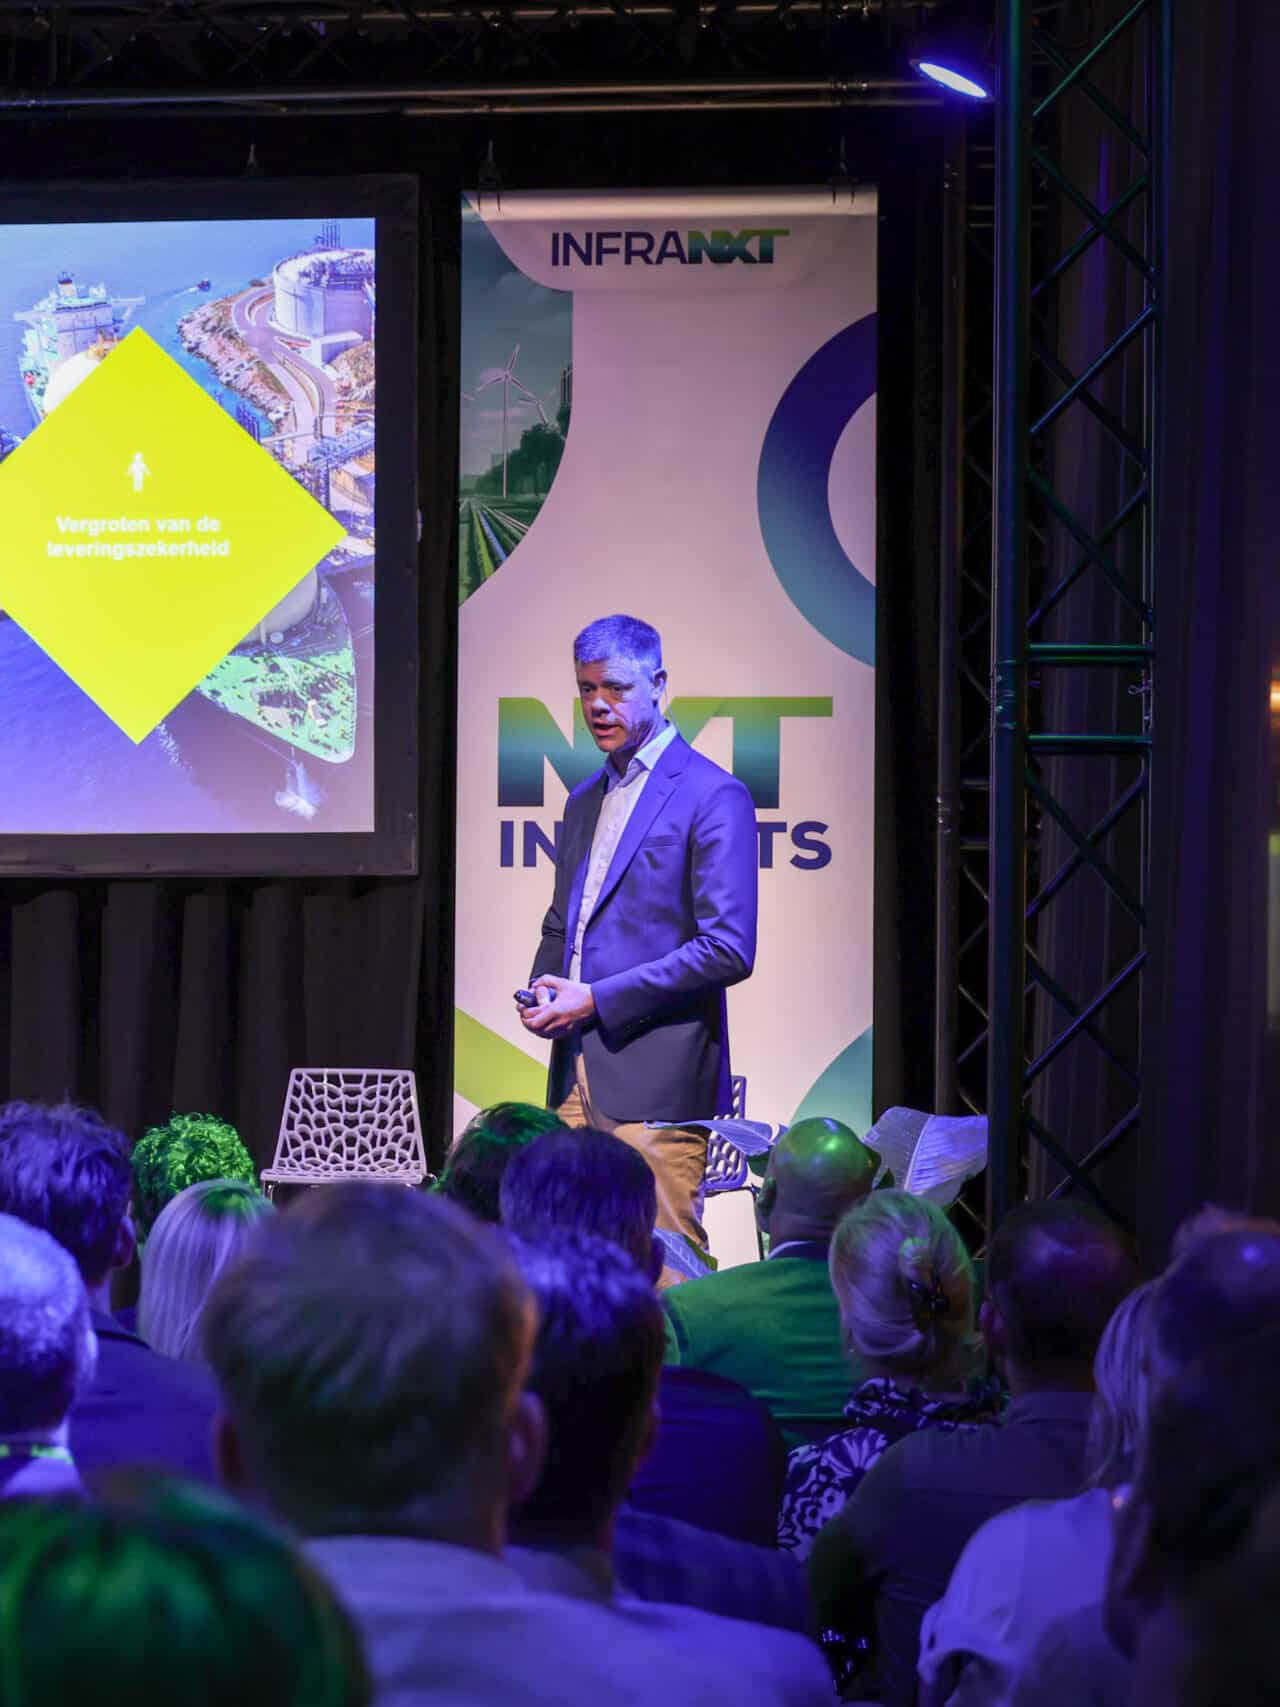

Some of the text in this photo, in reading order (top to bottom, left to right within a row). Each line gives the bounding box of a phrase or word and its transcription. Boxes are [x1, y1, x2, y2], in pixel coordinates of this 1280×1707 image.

[551, 228, 790, 266] INFRANXT
[156, 519, 191, 532] van
[196, 515, 220, 532] de
[47, 541, 230, 560] leveringszekerheid
[497, 696, 833, 809] NT
[499, 820, 833, 870] INTS
